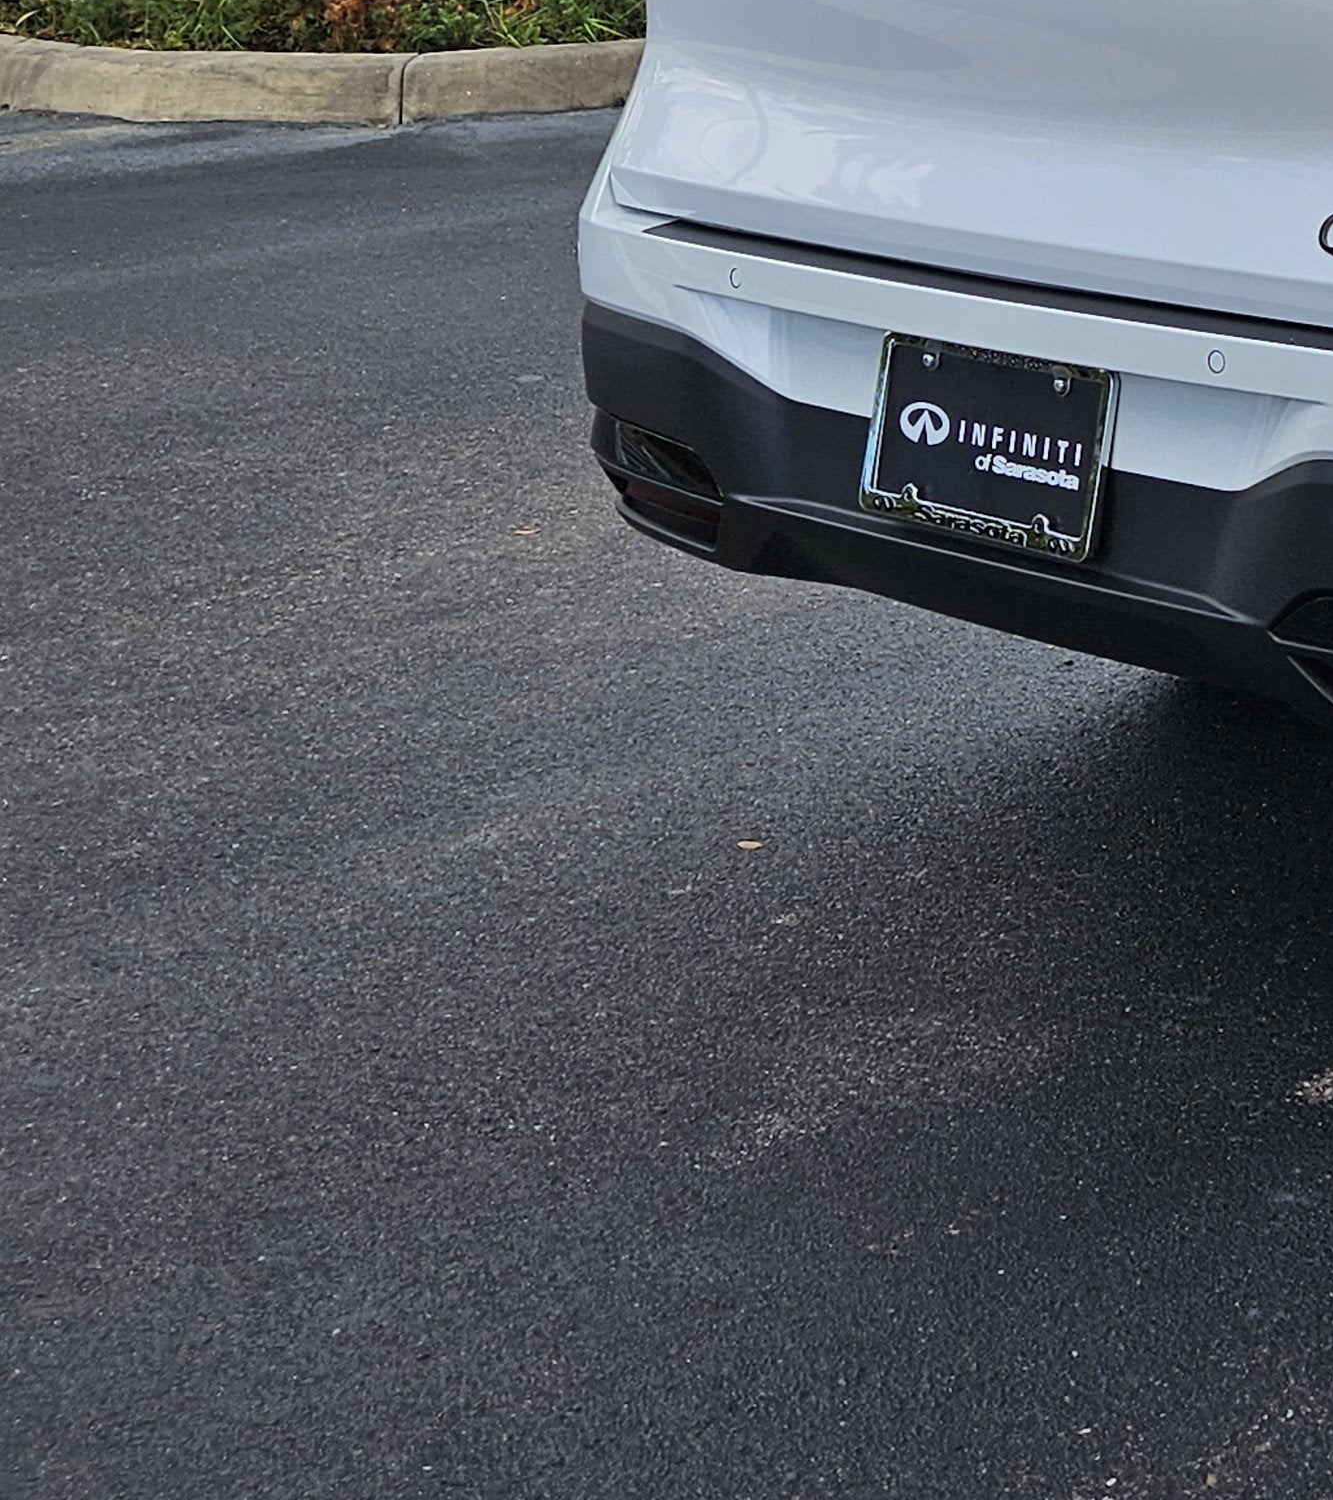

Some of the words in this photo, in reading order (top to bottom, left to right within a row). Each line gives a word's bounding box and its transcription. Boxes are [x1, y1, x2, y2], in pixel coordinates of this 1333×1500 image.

[957, 419, 1083, 467] INFINITI
[974, 453, 992, 472] of
[991, 455, 1080, 491] Sarasota
